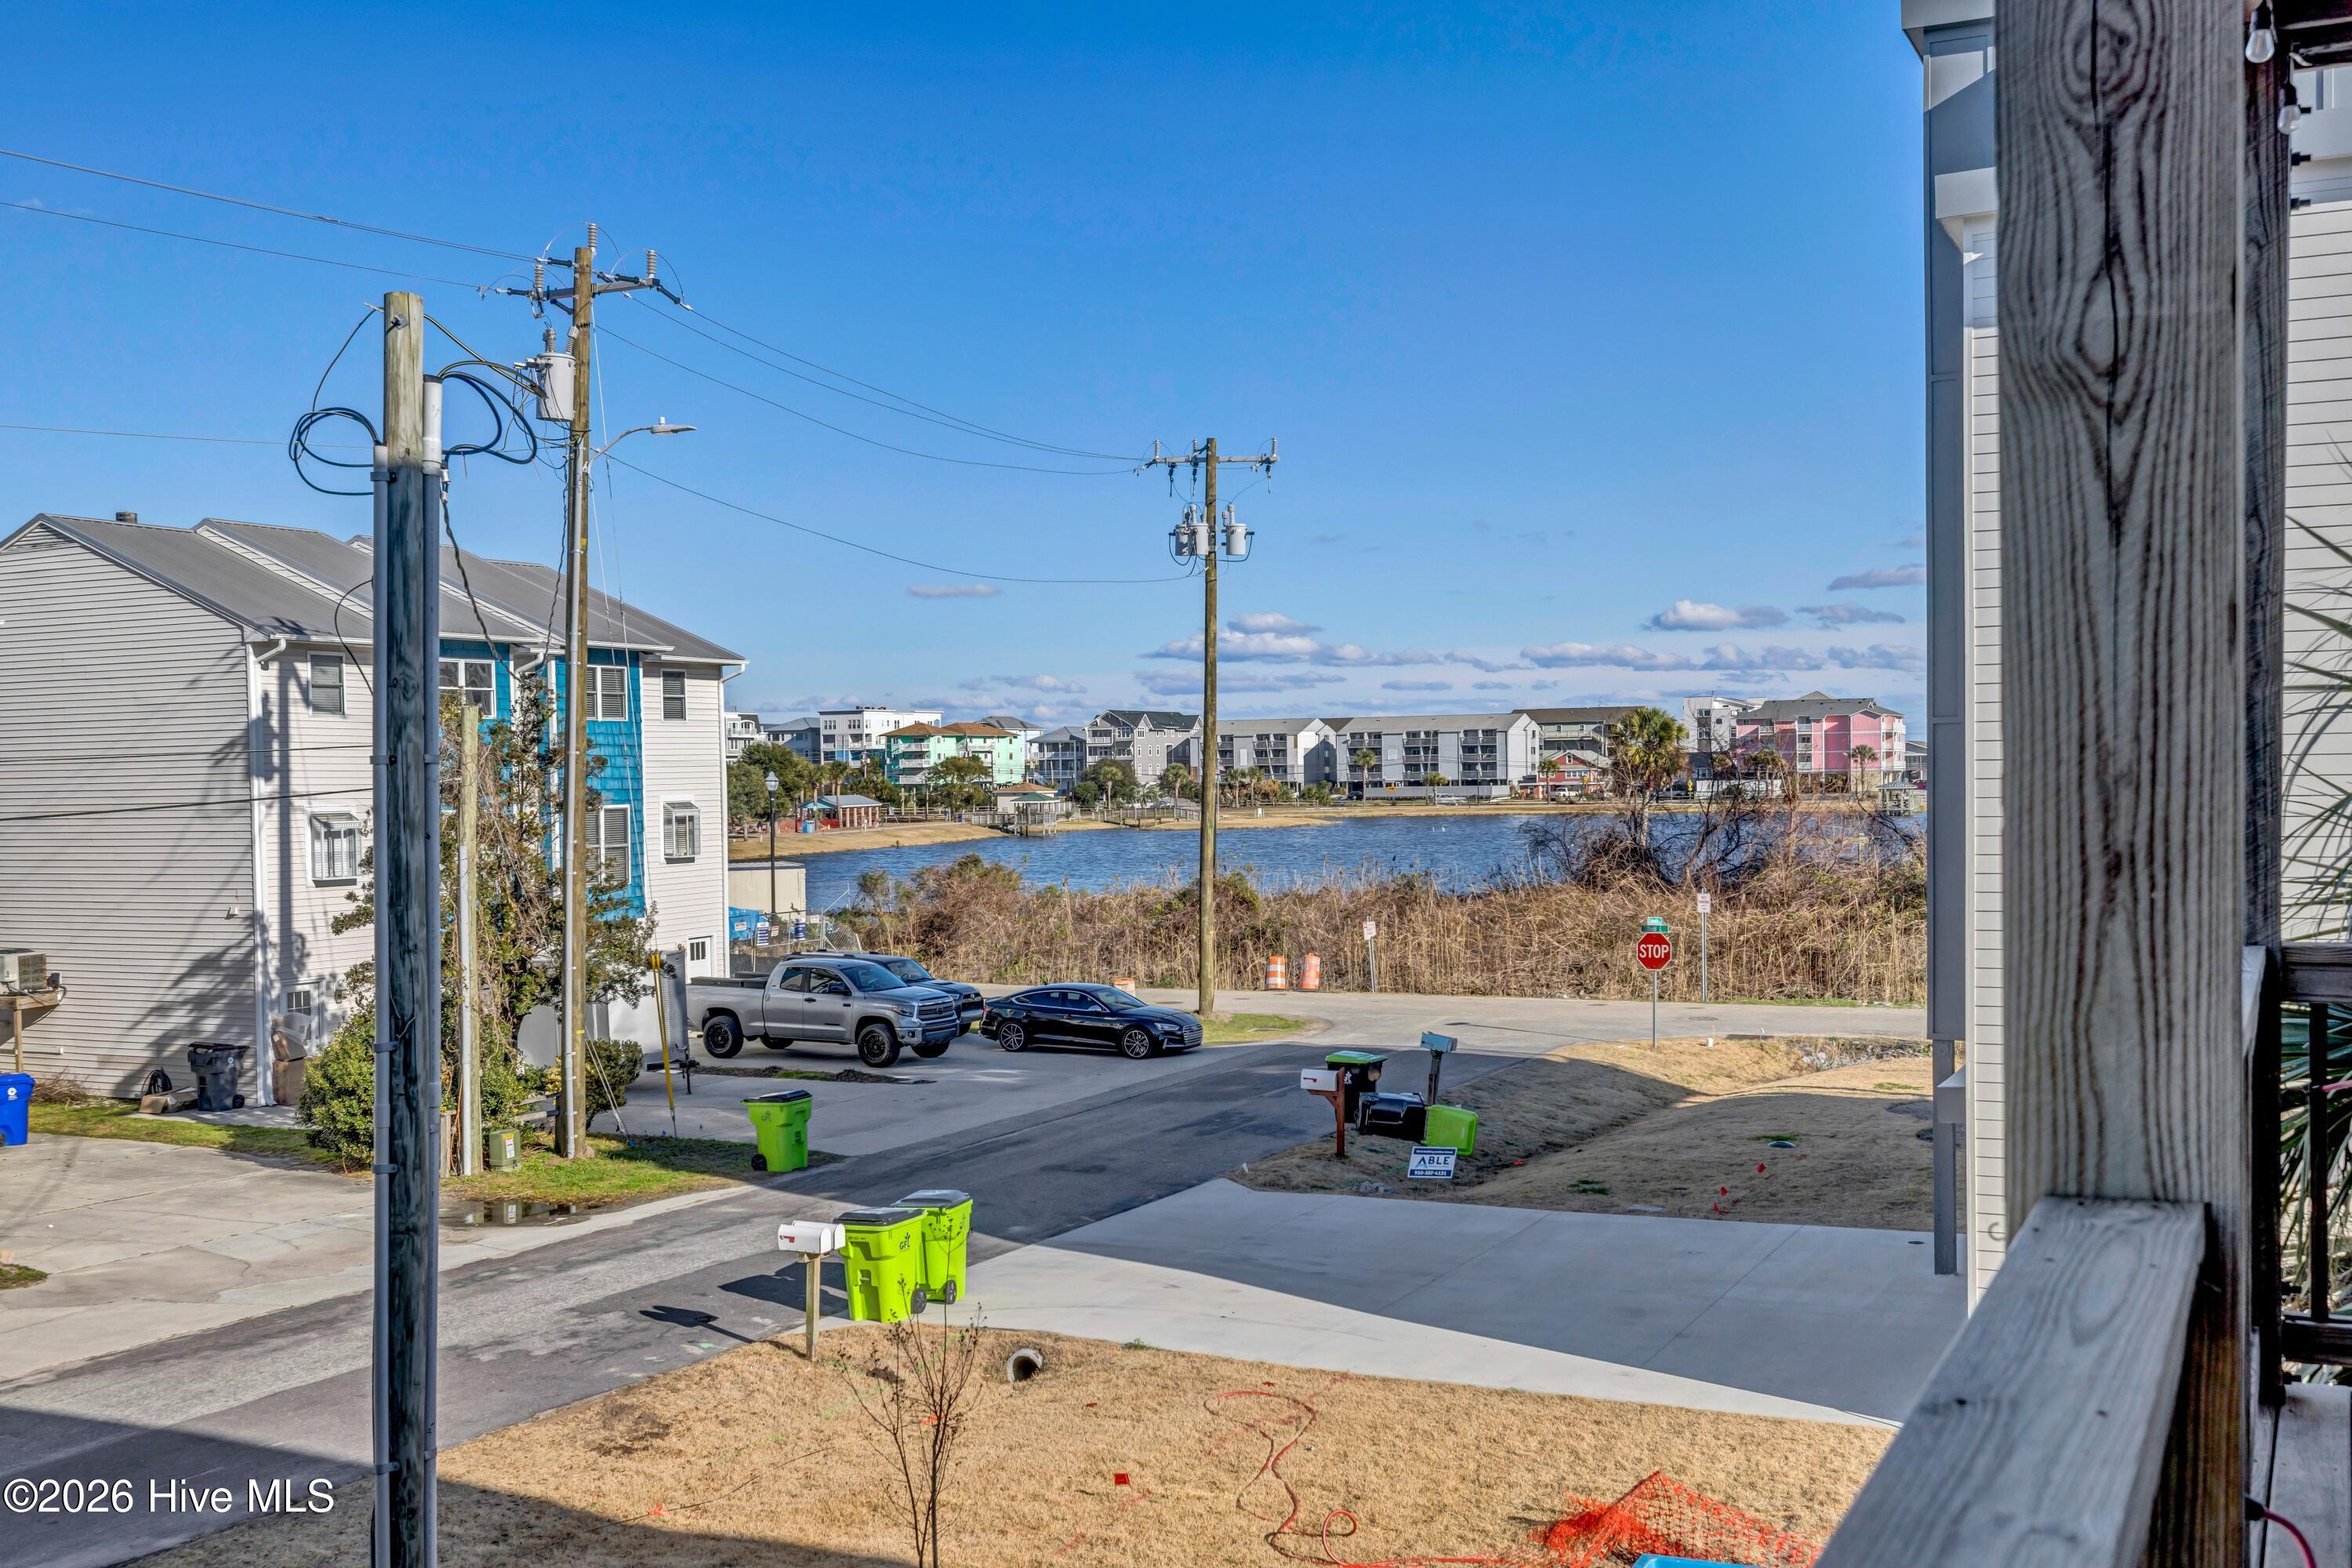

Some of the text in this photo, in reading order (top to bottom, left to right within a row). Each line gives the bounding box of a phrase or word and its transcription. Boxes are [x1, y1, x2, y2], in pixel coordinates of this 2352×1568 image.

[1639, 944, 1669, 958] STOP
[1416, 1156, 1450, 1167] ABLE
[899, 1236, 910, 1250] GFL
